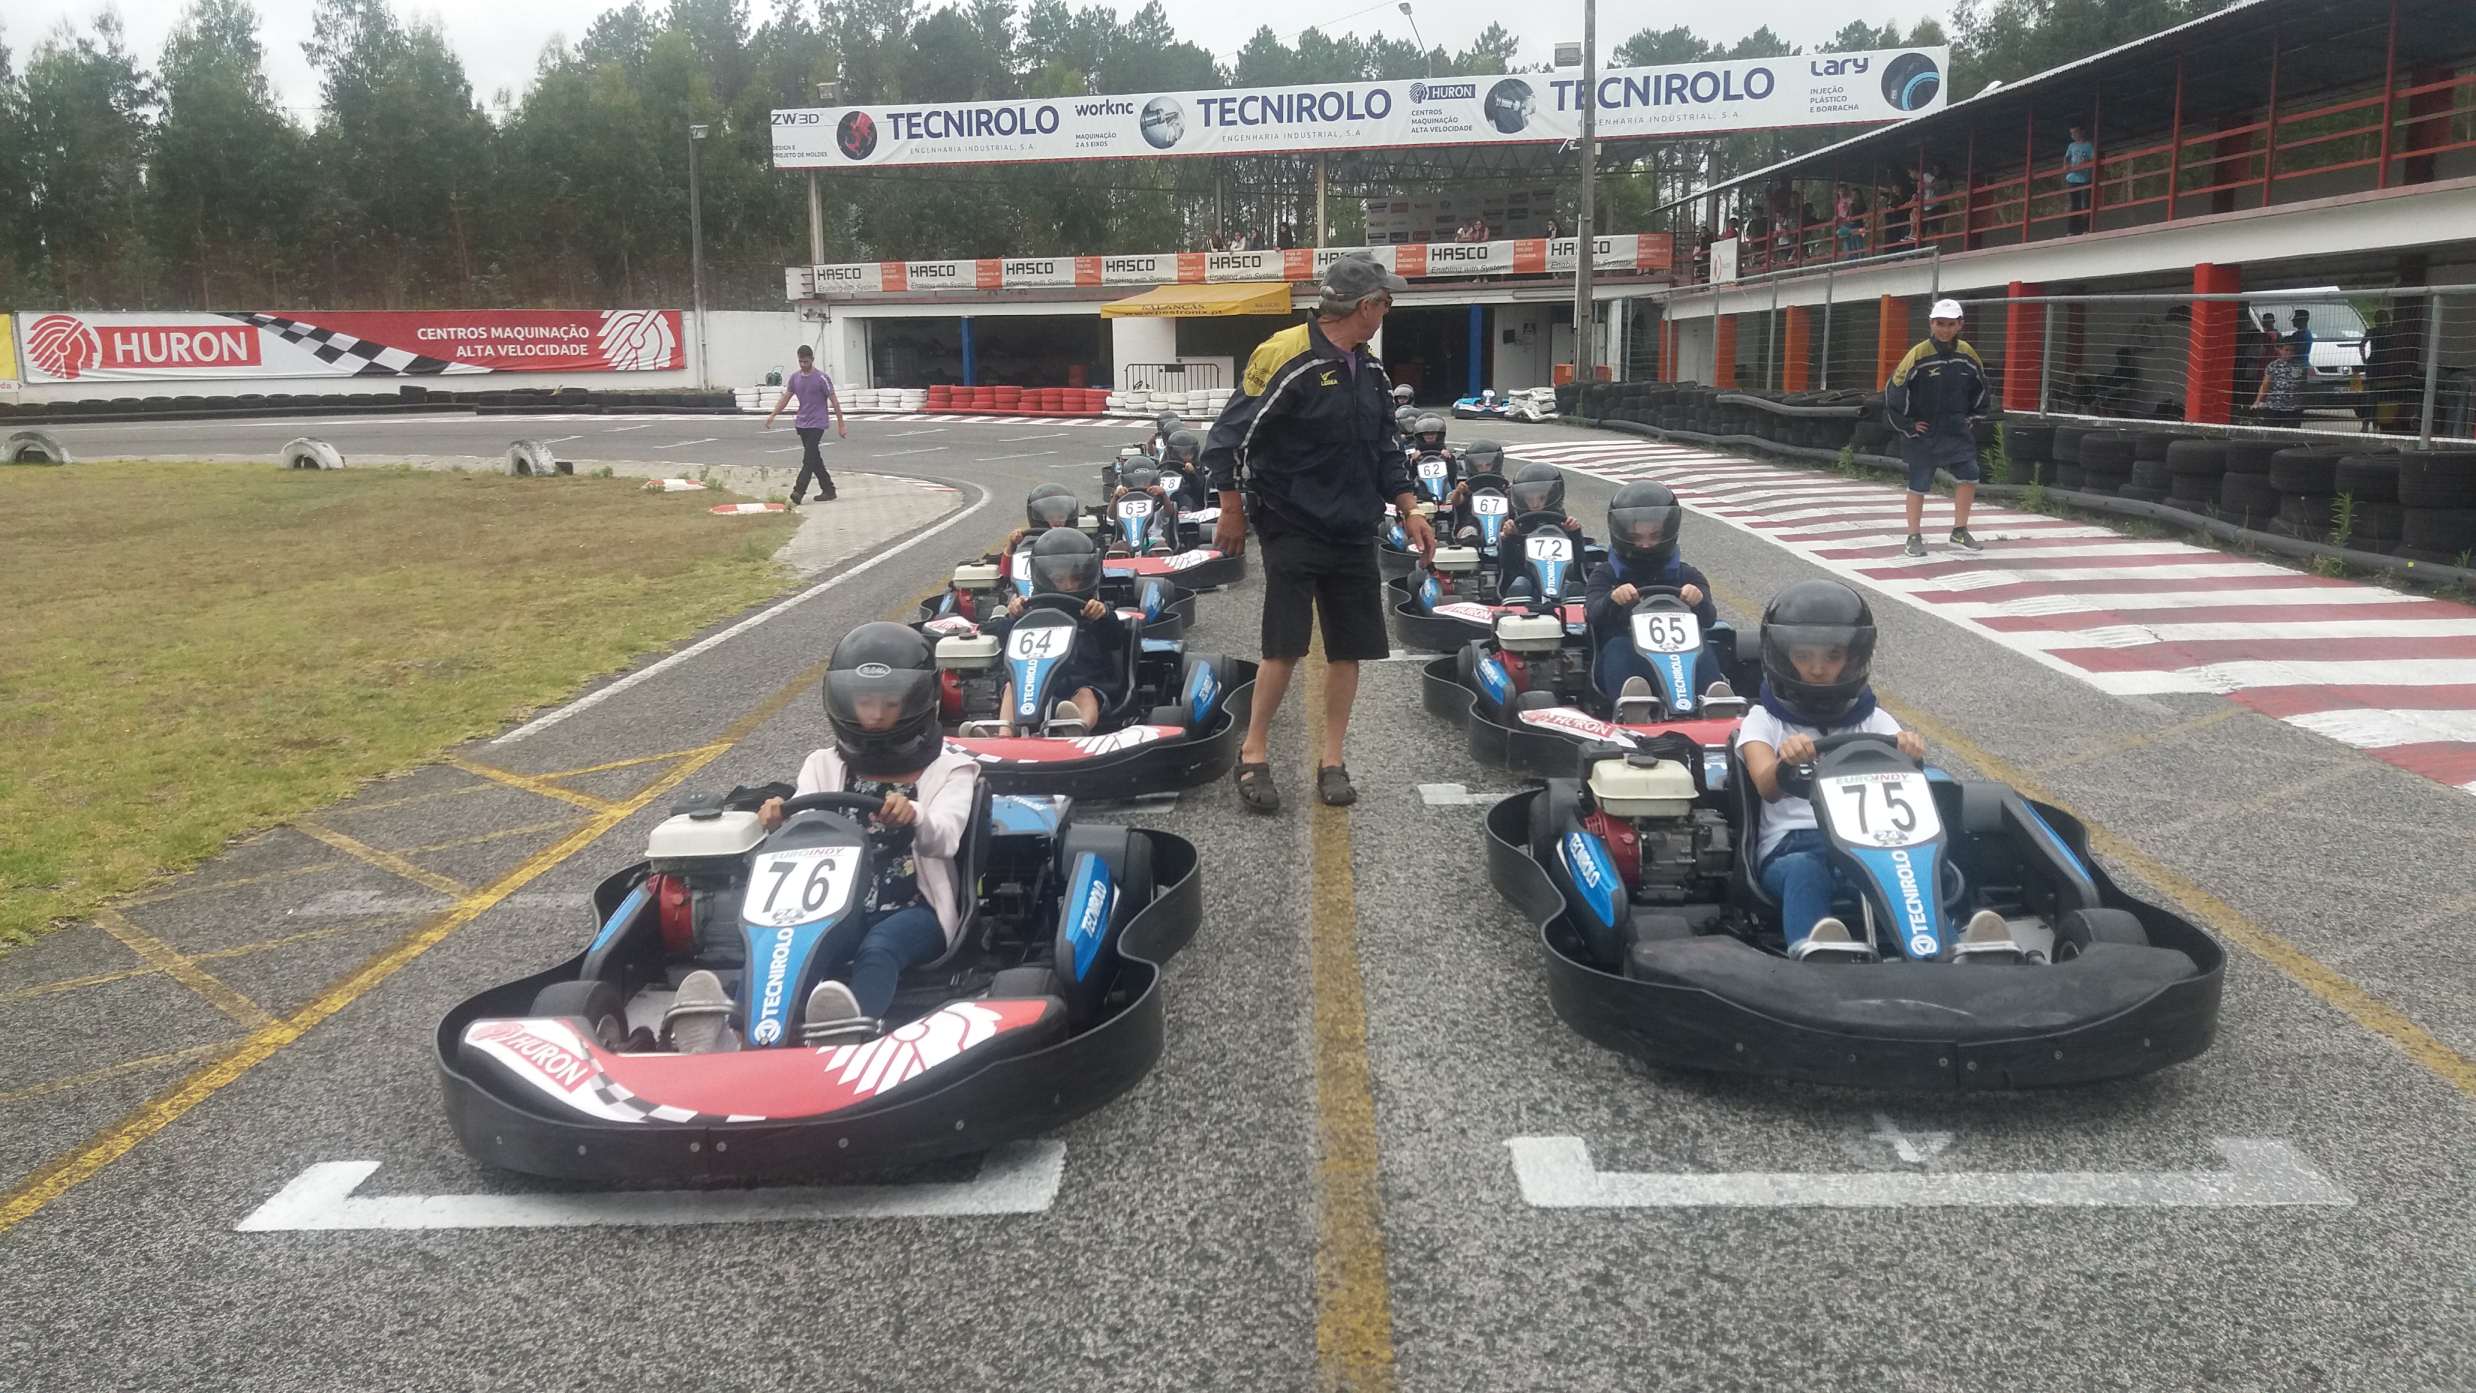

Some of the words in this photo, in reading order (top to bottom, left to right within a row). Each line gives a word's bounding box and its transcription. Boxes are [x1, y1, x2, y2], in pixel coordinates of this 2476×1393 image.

[1432, 86, 1472, 98] HURON
[1810, 86, 1844, 94] INJEÇÃO
[1810, 95, 1848, 104] PLÁSTICO
[1075, 99, 1133, 117] worknc
[1197, 89, 1392, 127] TECNIROLO
[1816, 104, 1859, 112] BORRACHA
[886, 105, 1060, 140] TECNIROLO
[1411, 116, 1458, 125] MAQUINAÇÃO
[1075, 132, 1116, 141] MAQUINAÇÃO
[1223, 133, 1279, 142] ENGENHARIA
[910, 146, 962, 155] ENGENHARIA
[1432, 246, 1488, 261] HASCO
[1551, 240, 1610, 256] HAO
[1006, 262, 1054, 275] HASCO
[1106, 259, 1156, 272] HASCO
[1210, 256, 1261, 269] HASCO
[817, 268, 862, 280] HASCO
[910, 265, 956, 278] HASCO
[1432, 266, 1461, 274] Enabling
[417, 327, 488, 340] CENTROS
[491, 324, 590, 341] MAQUINAÇÃO
[114, 332, 248, 363] HURON
[456, 345, 495, 357] ALTA
[497, 344, 589, 356] VELOCIDADE
[1423, 463, 1440, 476] 62
[1125, 502, 1147, 515] 63
[1480, 498, 1500, 512] 67
[1535, 539, 1562, 557] 72
[1649, 616, 1686, 645] 65
[1020, 629, 1052, 655] 64
[1669, 654, 1687, 699] TECNIROLO
[1552, 716, 1609, 736] HURON
[1841, 782, 1917, 834] 75
[762, 858, 836, 913] 76
[1891, 850, 1928, 936] TECNIROLO
[760, 927, 795, 1019] TECNIROLO
[511, 1033, 589, 1087] HURON
